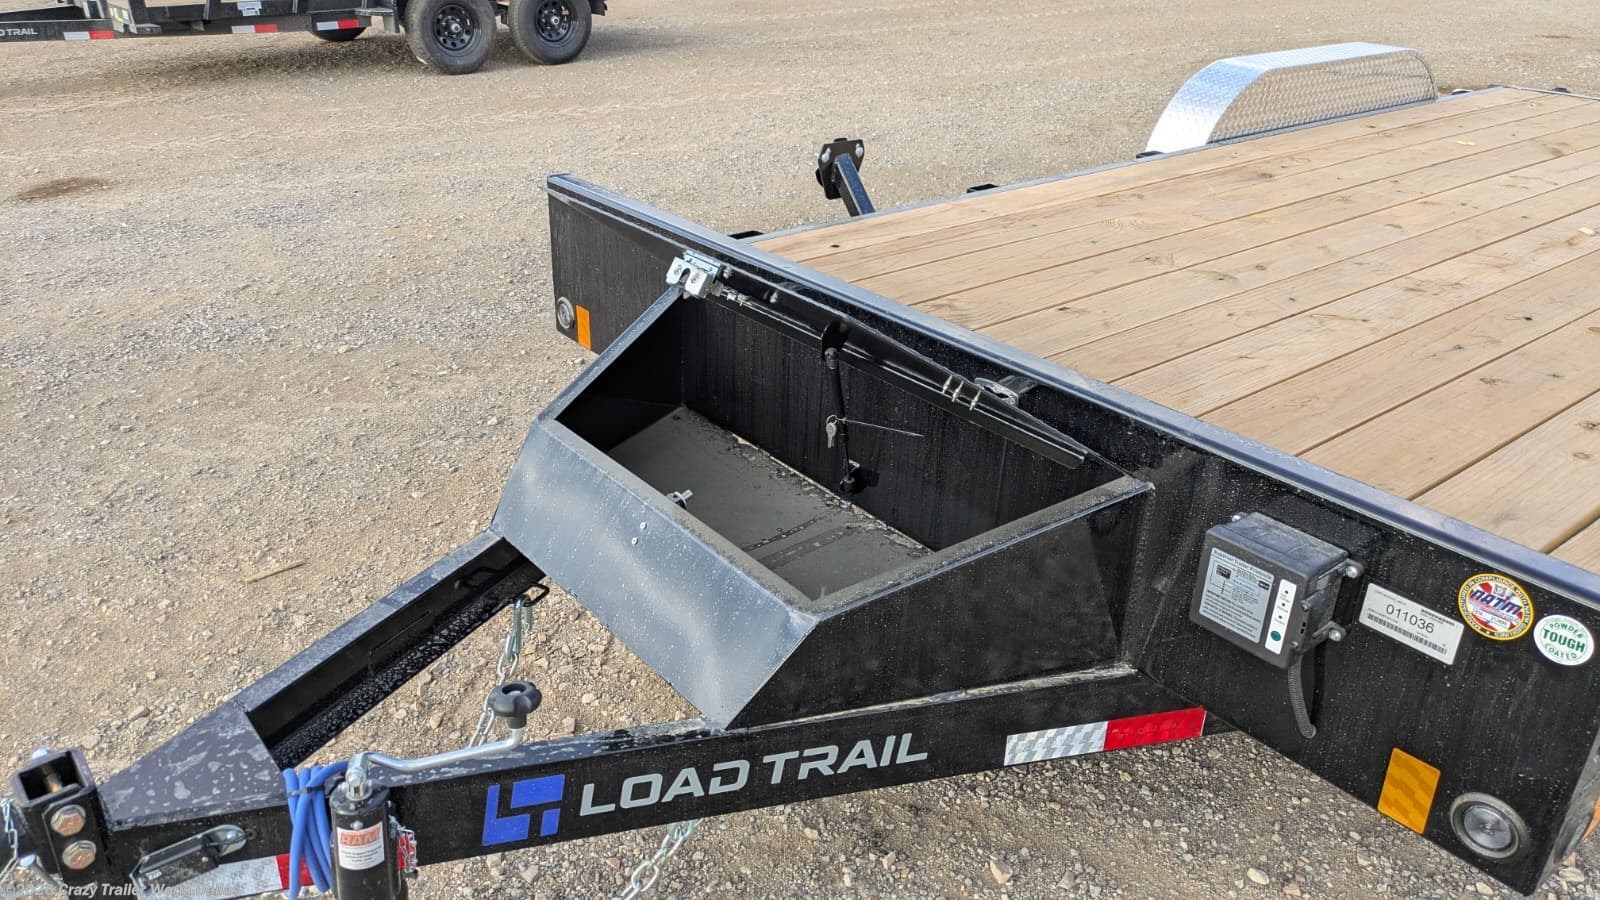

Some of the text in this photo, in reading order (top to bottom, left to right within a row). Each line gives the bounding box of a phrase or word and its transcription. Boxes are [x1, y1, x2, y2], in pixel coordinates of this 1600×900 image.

[6, 28, 38, 36] TRAIL
[1385, 603, 1435, 634] 011036
[1543, 628, 1586, 653] TOUGH
[1549, 622, 1584, 639] POWDER
[1545, 643, 1578, 660] COATED
[579, 759, 750, 816] LOAD
[761, 732, 929, 785] TRAIL
